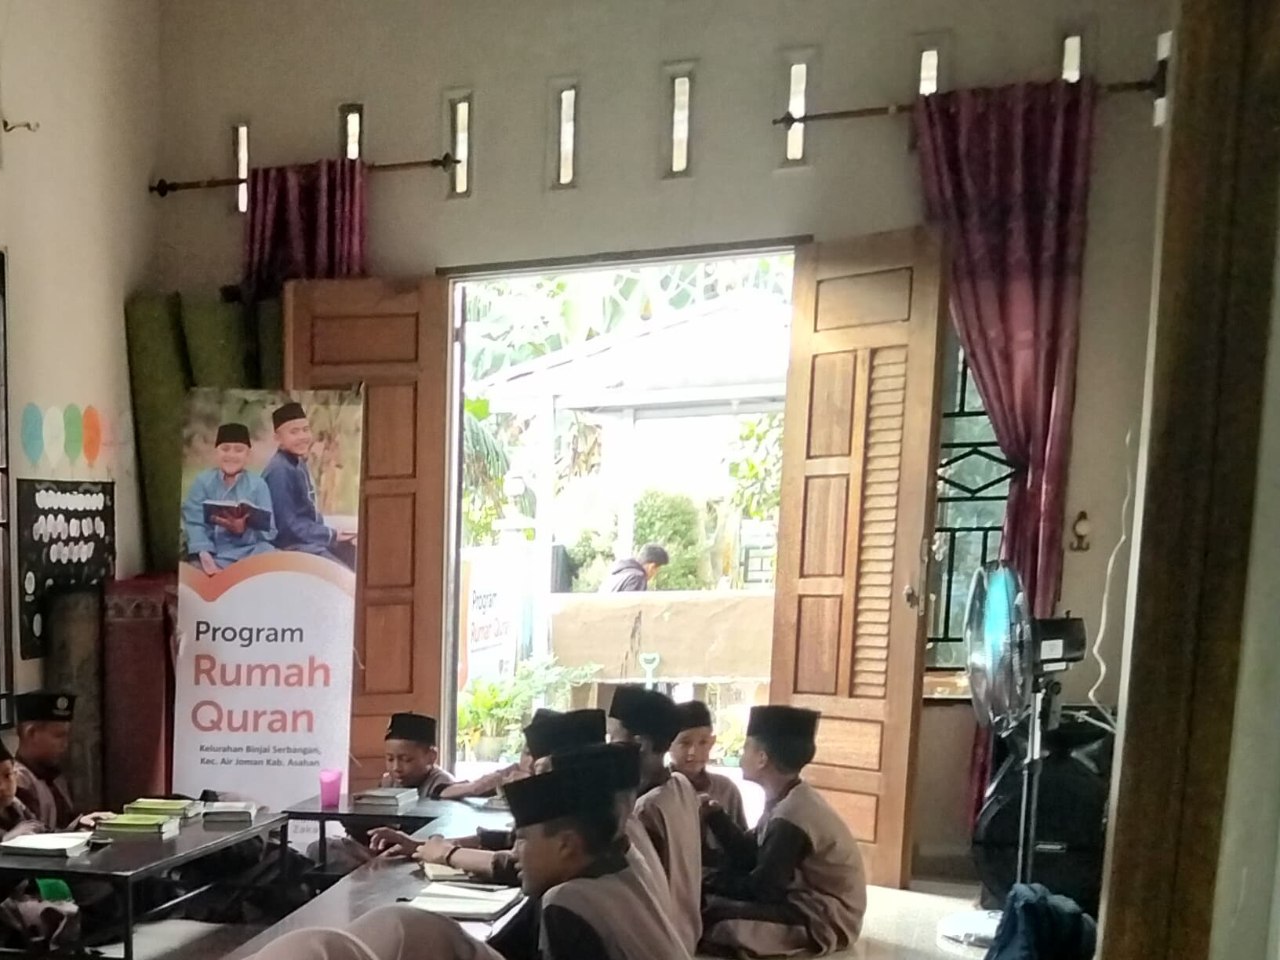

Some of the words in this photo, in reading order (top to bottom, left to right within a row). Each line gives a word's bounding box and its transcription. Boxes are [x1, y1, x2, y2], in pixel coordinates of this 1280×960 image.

[195, 620, 304, 648] Program
[194, 654, 331, 687] Rumah
[191, 700, 314, 733] Quran
[199, 744, 244, 754] Kelurahan
[245, 745, 270, 756] Binjai
[200, 757, 218, 766] Kec.
[220, 758, 233, 767] Air
[235, 758, 264, 767] Joman
[266, 759, 285, 767] Kab.
[287, 759, 320, 767] Asahan
